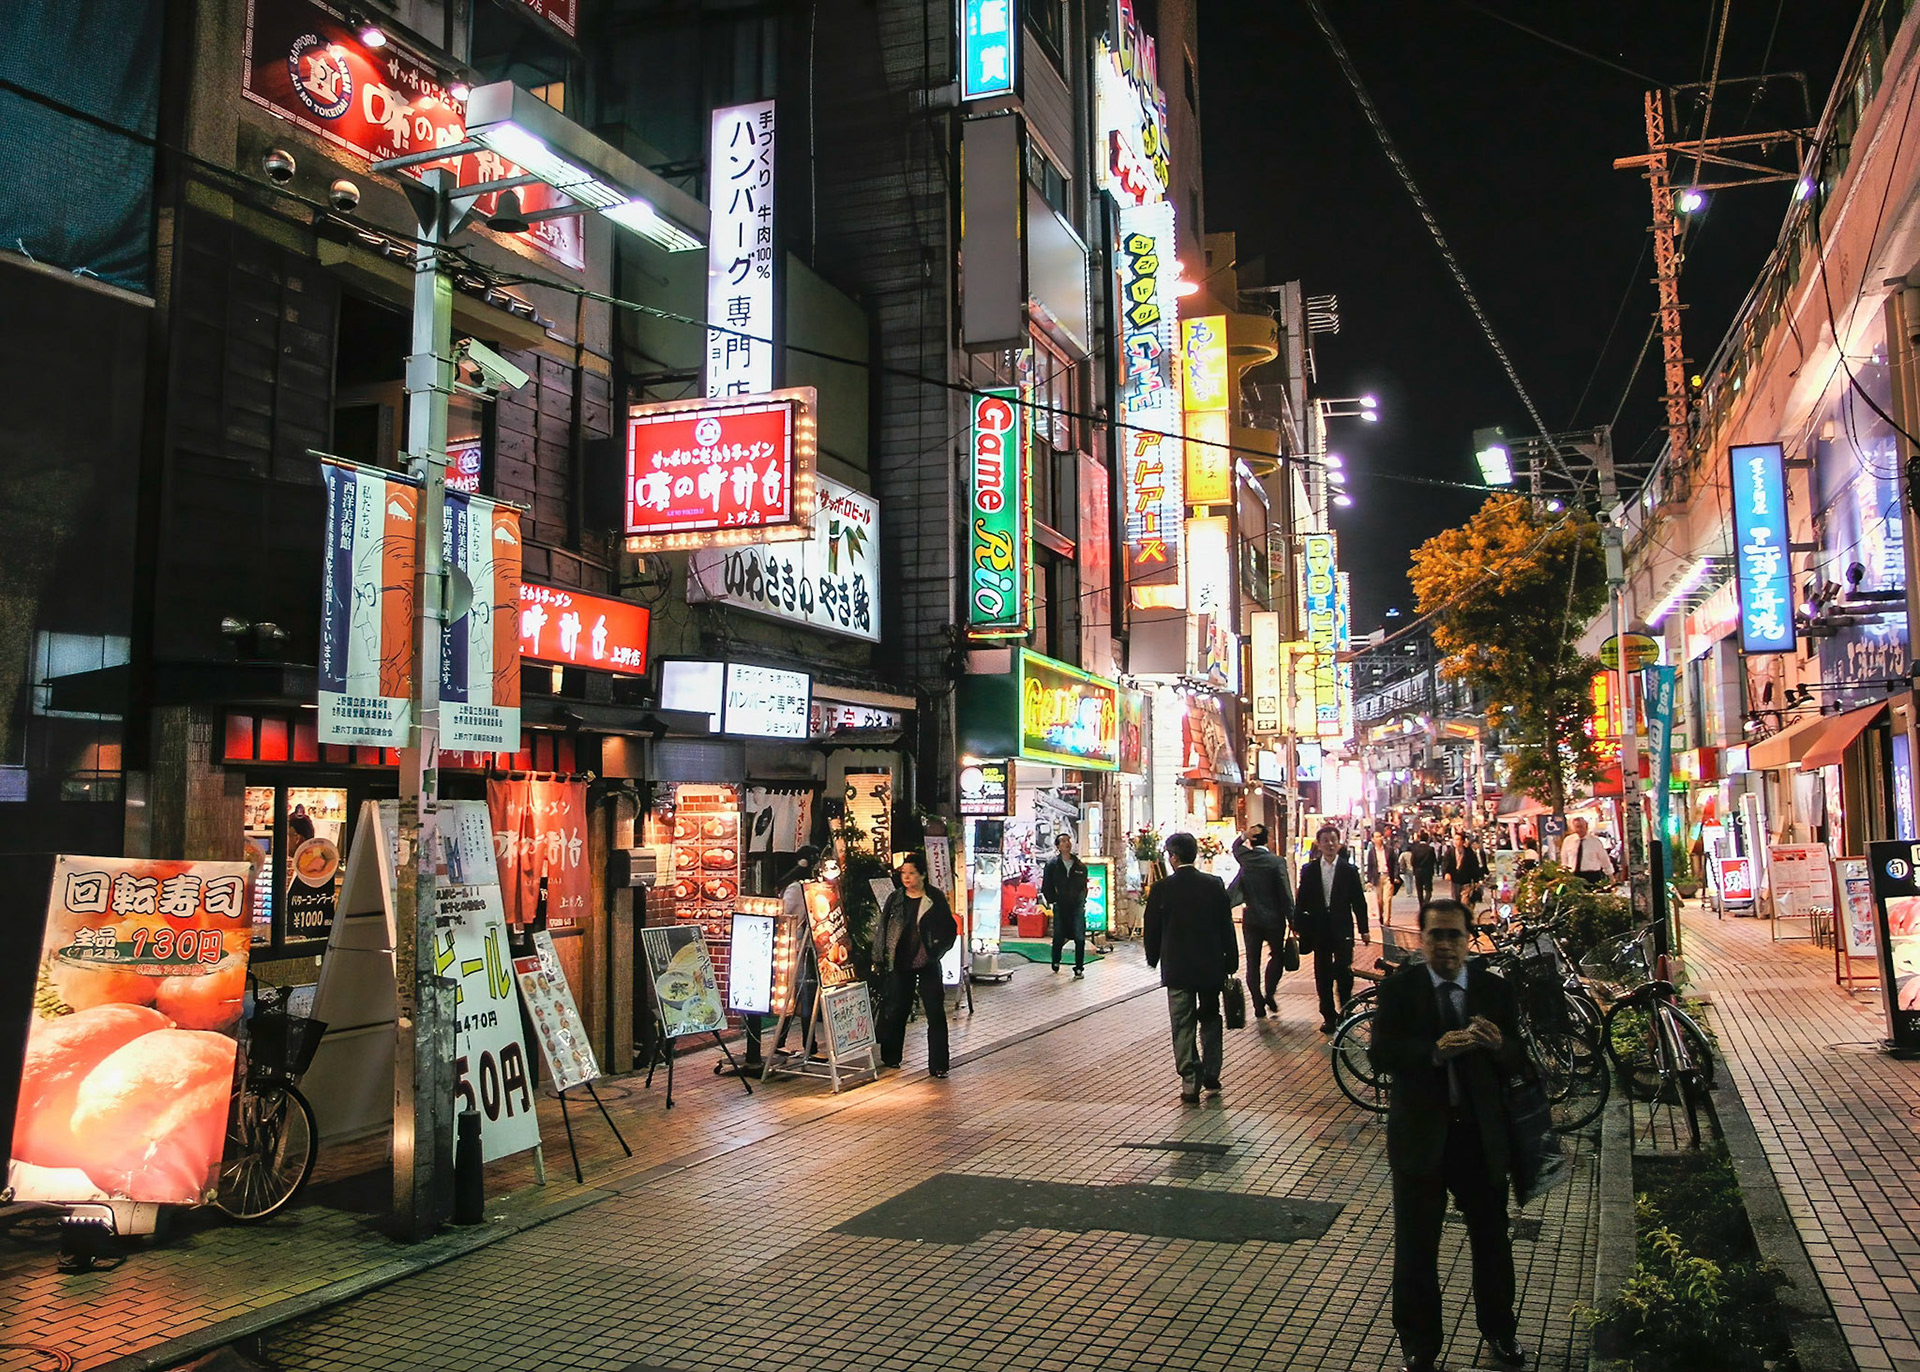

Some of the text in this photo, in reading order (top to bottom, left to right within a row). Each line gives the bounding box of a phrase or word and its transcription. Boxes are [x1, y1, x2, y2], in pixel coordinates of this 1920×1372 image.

[289, 34, 318, 65] SAPPORO
[290, 72, 349, 118] AJI NO TOKEIDAI
[388, 58, 466, 115] サッポロこだわ
[757, 111, 773, 279] 手づくり 牛肉100%
[1134, 240, 1149, 250] 3F
[1138, 260, 1155, 270] 2F
[1137, 286, 1149, 296] 1F
[1125, 331, 1165, 412] GAME
[651, 441, 775, 469] サッポロこだわりラーメン
[635, 459, 782, 513] 味の時計台
[819, 488, 871, 525] サッポロビール
[975, 396, 1015, 618] Game Rio
[1133, 431, 1167, 564] アドアーズ
[340, 481, 355, 550] 西洋美術館
[361, 485, 372, 539] 私たちは
[724, 510, 761, 525] 上野店
[522, 603, 608, 660] 時計台
[610, 645, 642, 666] 上野店
[1890, 860, 1904, 877] 旬
[64, 871, 244, 918] 回転寿司
[293, 910, 324, 928] ¥1000
[73, 926, 223, 964] 全品 130円
